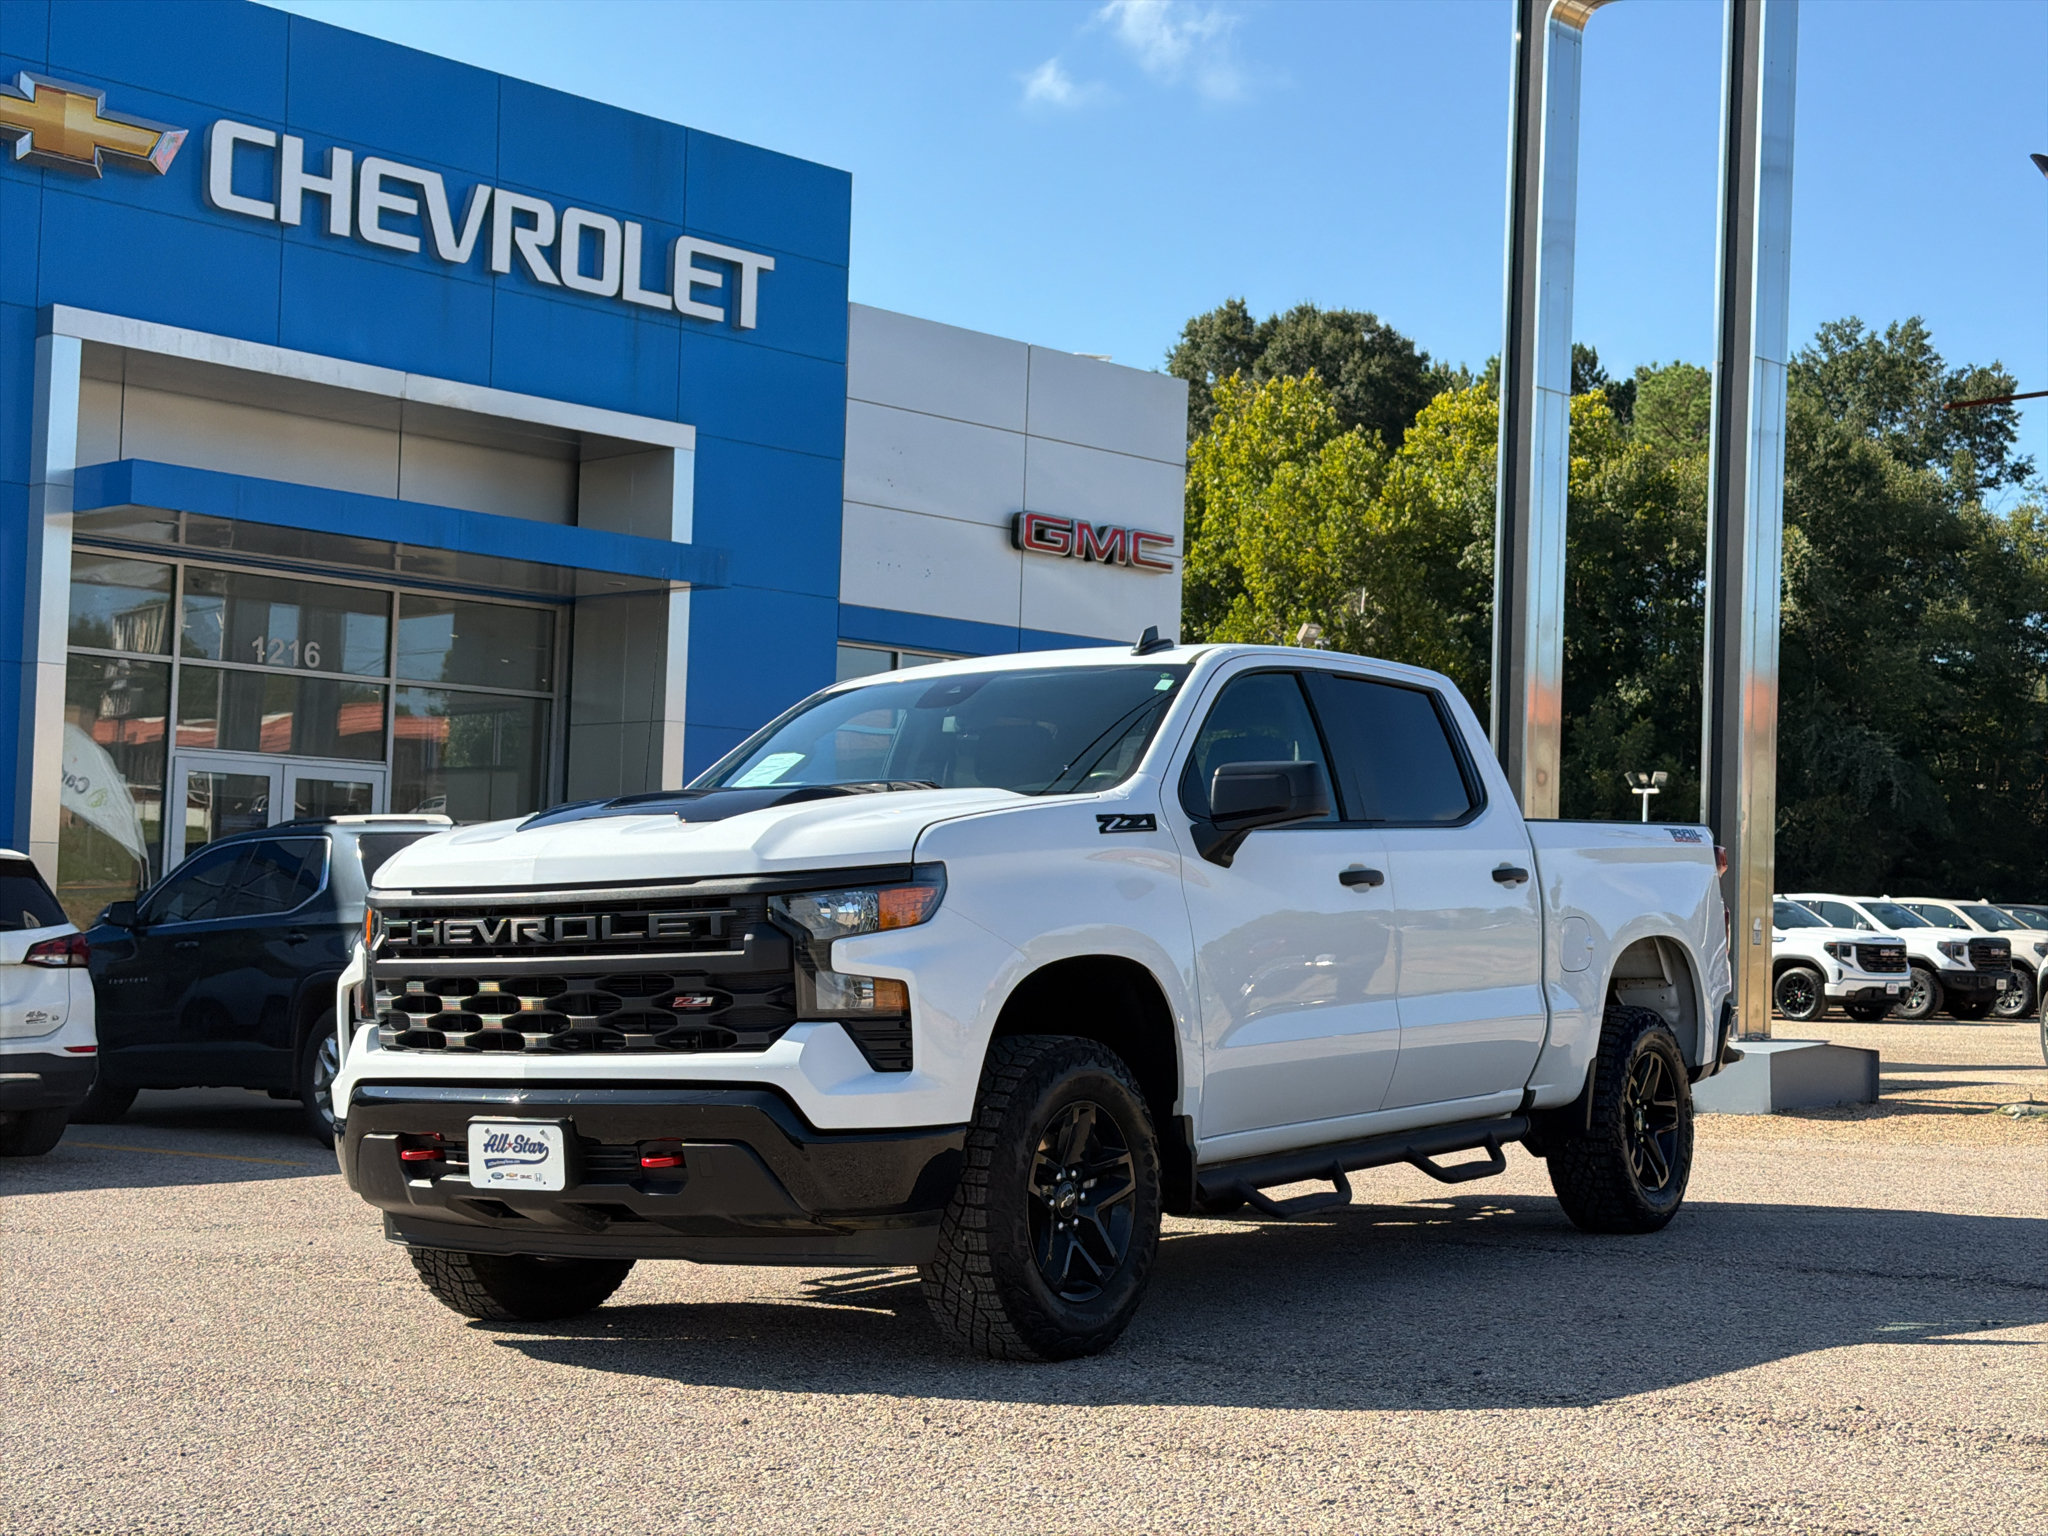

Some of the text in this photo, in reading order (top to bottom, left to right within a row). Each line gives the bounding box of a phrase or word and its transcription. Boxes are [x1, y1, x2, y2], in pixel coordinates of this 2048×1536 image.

[206, 119, 776, 329] CHEVROLET
[1013, 511, 1175, 573] GMC
[251, 635, 321, 668] 1216
[1095, 813, 1157, 834] Z71
[1663, 828, 1703, 839] TRAIL
[383, 910, 737, 946] CHEVROLET
[672, 996, 713, 1008] Z71
